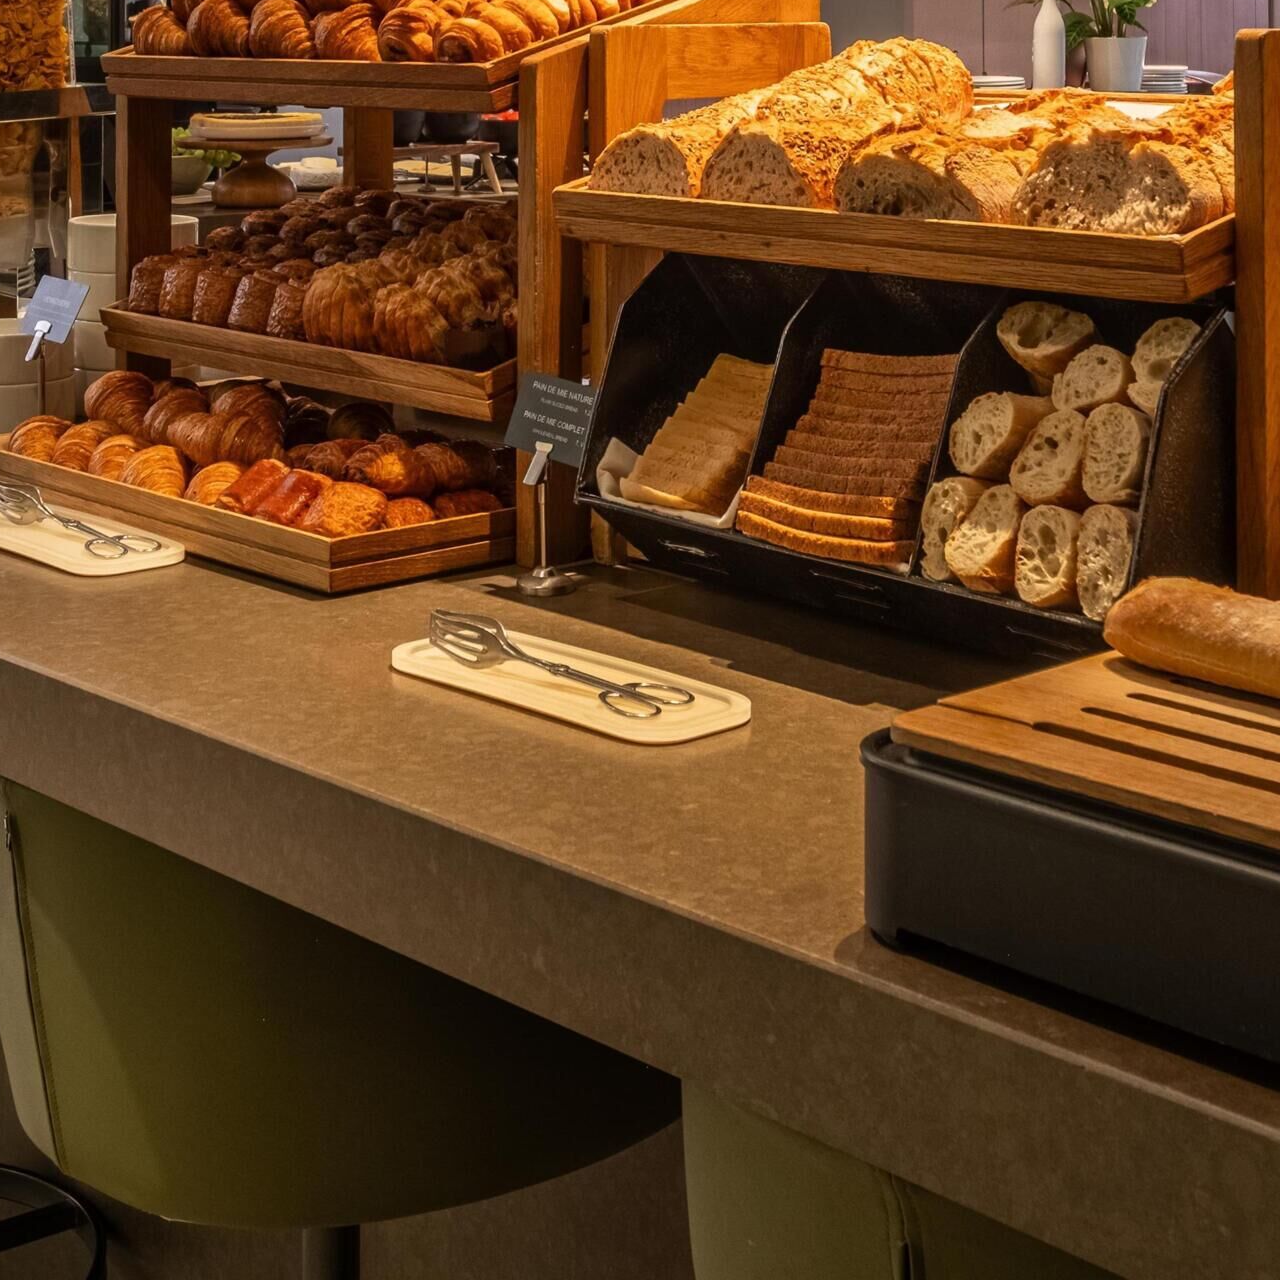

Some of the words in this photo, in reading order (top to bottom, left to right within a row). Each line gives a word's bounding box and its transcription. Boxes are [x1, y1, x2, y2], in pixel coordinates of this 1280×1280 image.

[532, 380, 548, 392] PAIN
[547, 385, 557, 394] DE
[557, 387, 569, 398] MIE
[569, 391, 594, 406] NATURE
[523, 409, 538, 421] PAIN
[537, 414, 546, 424] DE
[546, 416, 557, 427] MIE
[557, 421, 585, 434] COMPLET
